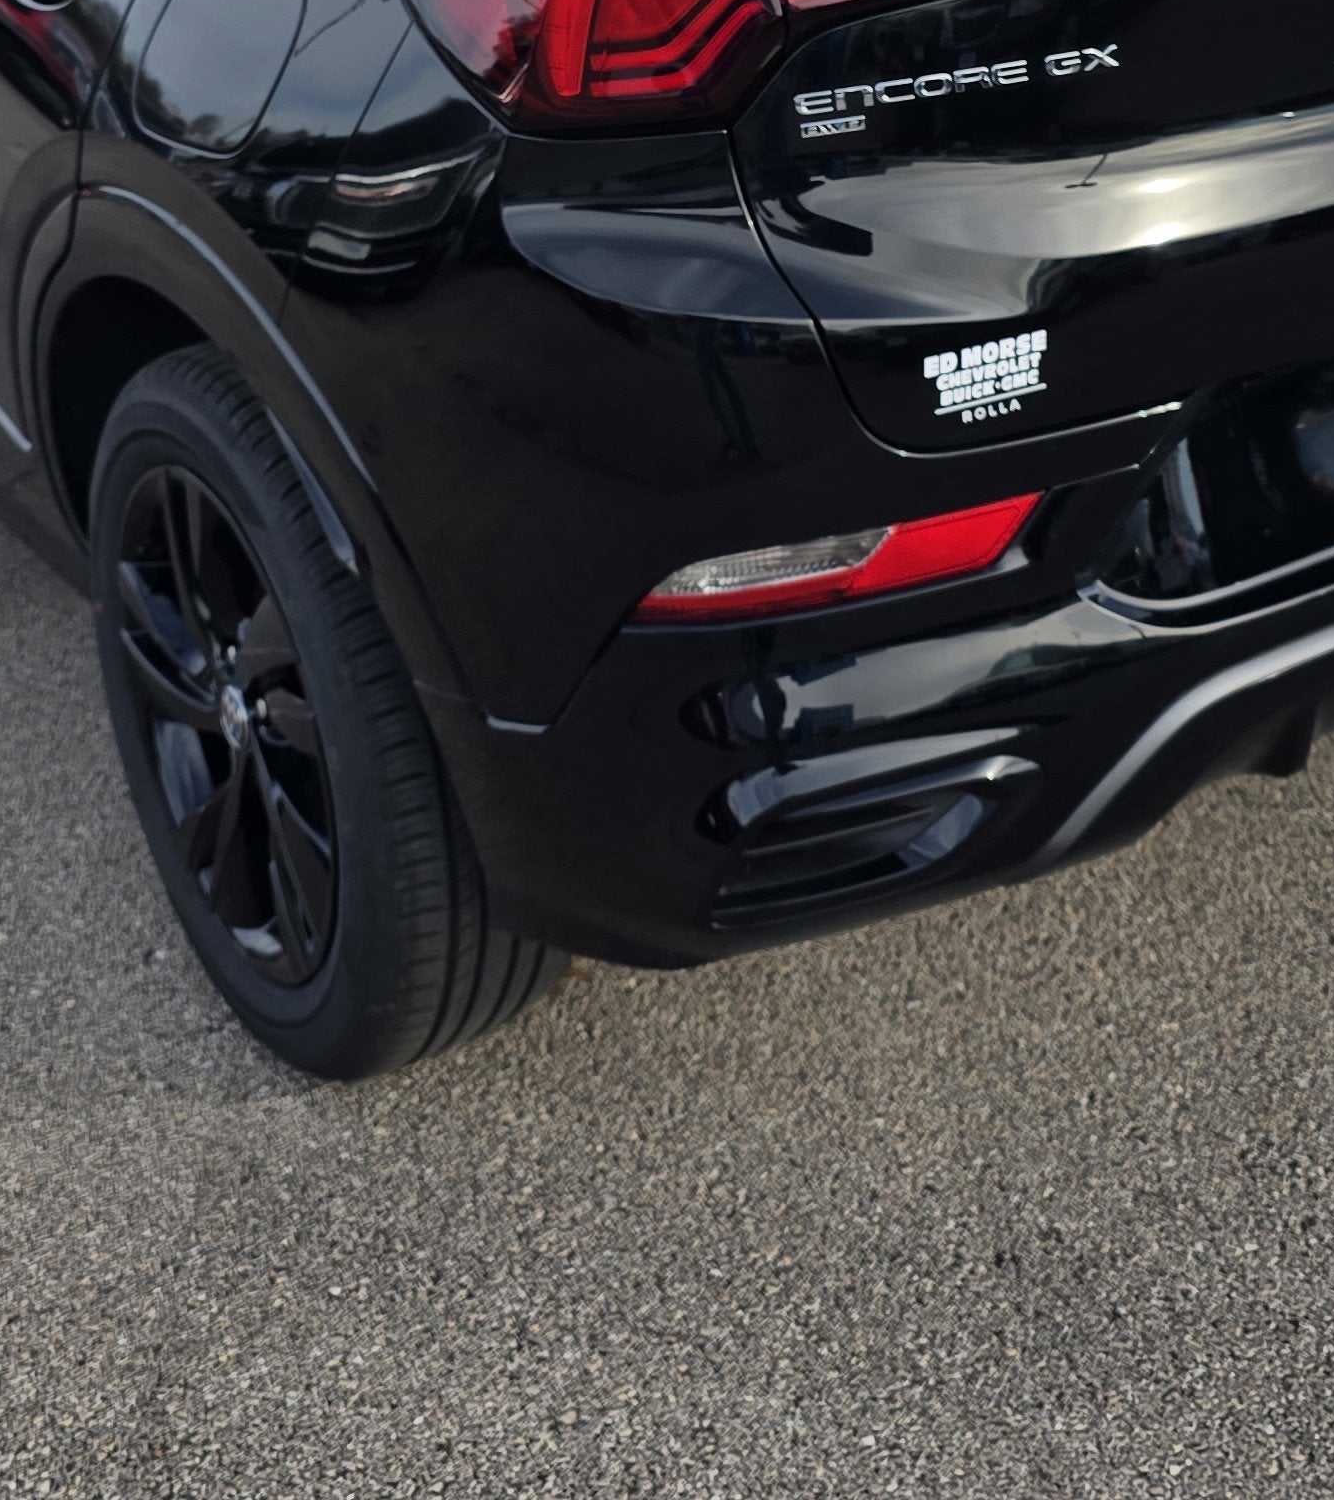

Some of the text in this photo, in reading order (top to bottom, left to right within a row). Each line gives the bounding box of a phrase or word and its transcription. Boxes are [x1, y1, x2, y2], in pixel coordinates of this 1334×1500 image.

[793, 43, 1120, 116] ENCORE GX
[923, 329, 1048, 379] ED MORSE
[936, 351, 1042, 391] CHEVROLET
[961, 398, 1022, 425] ROLLA
